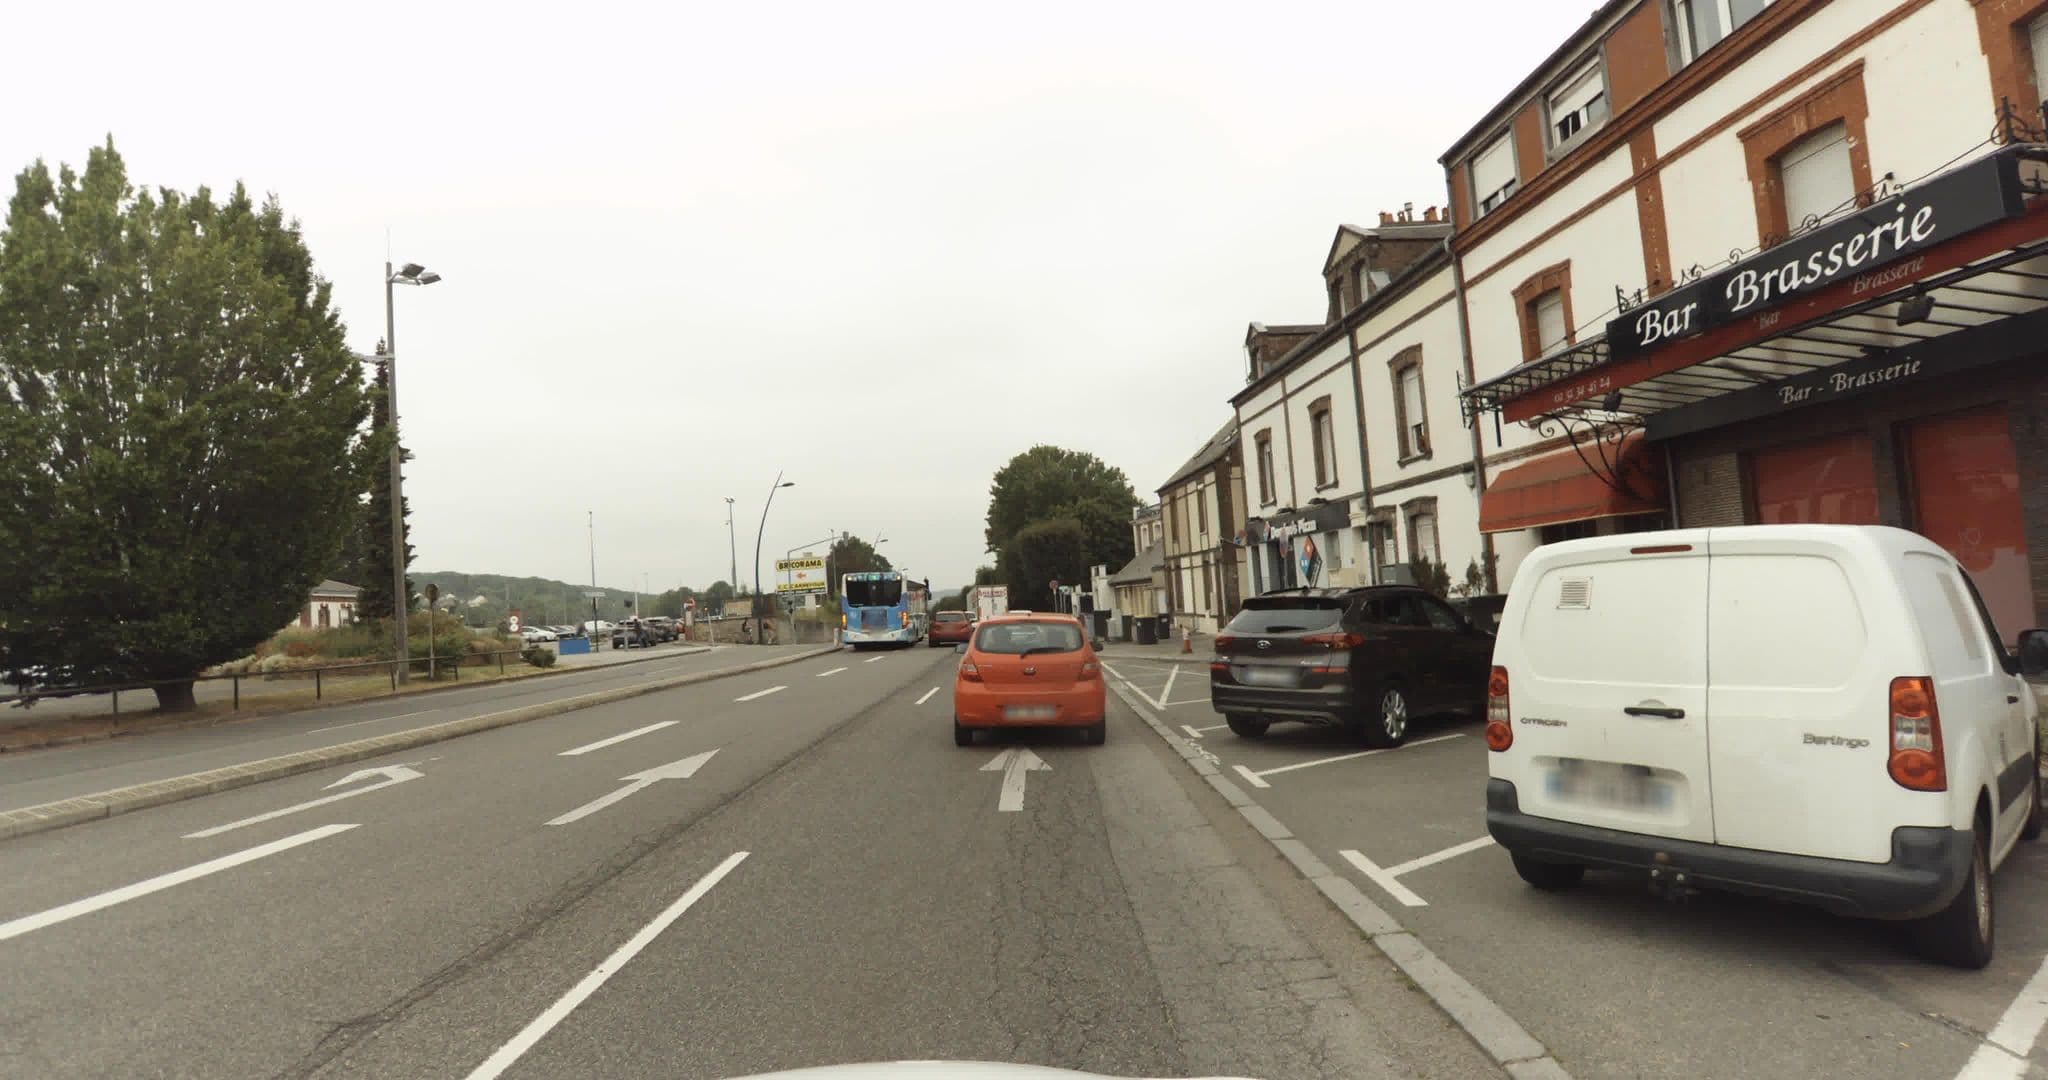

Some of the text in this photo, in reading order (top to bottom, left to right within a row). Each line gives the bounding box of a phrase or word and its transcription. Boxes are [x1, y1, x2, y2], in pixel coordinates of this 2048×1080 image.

[1636, 202, 1937, 347] Bar Brasserie
[1849, 256, 1926, 295] Brasserie
[1778, 382, 1812, 406] Bar
[1829, 357, 1922, 395] Brasserie
[778, 559, 822, 570] BRICORAMA
[1803, 733, 1869, 748] Berlingo
